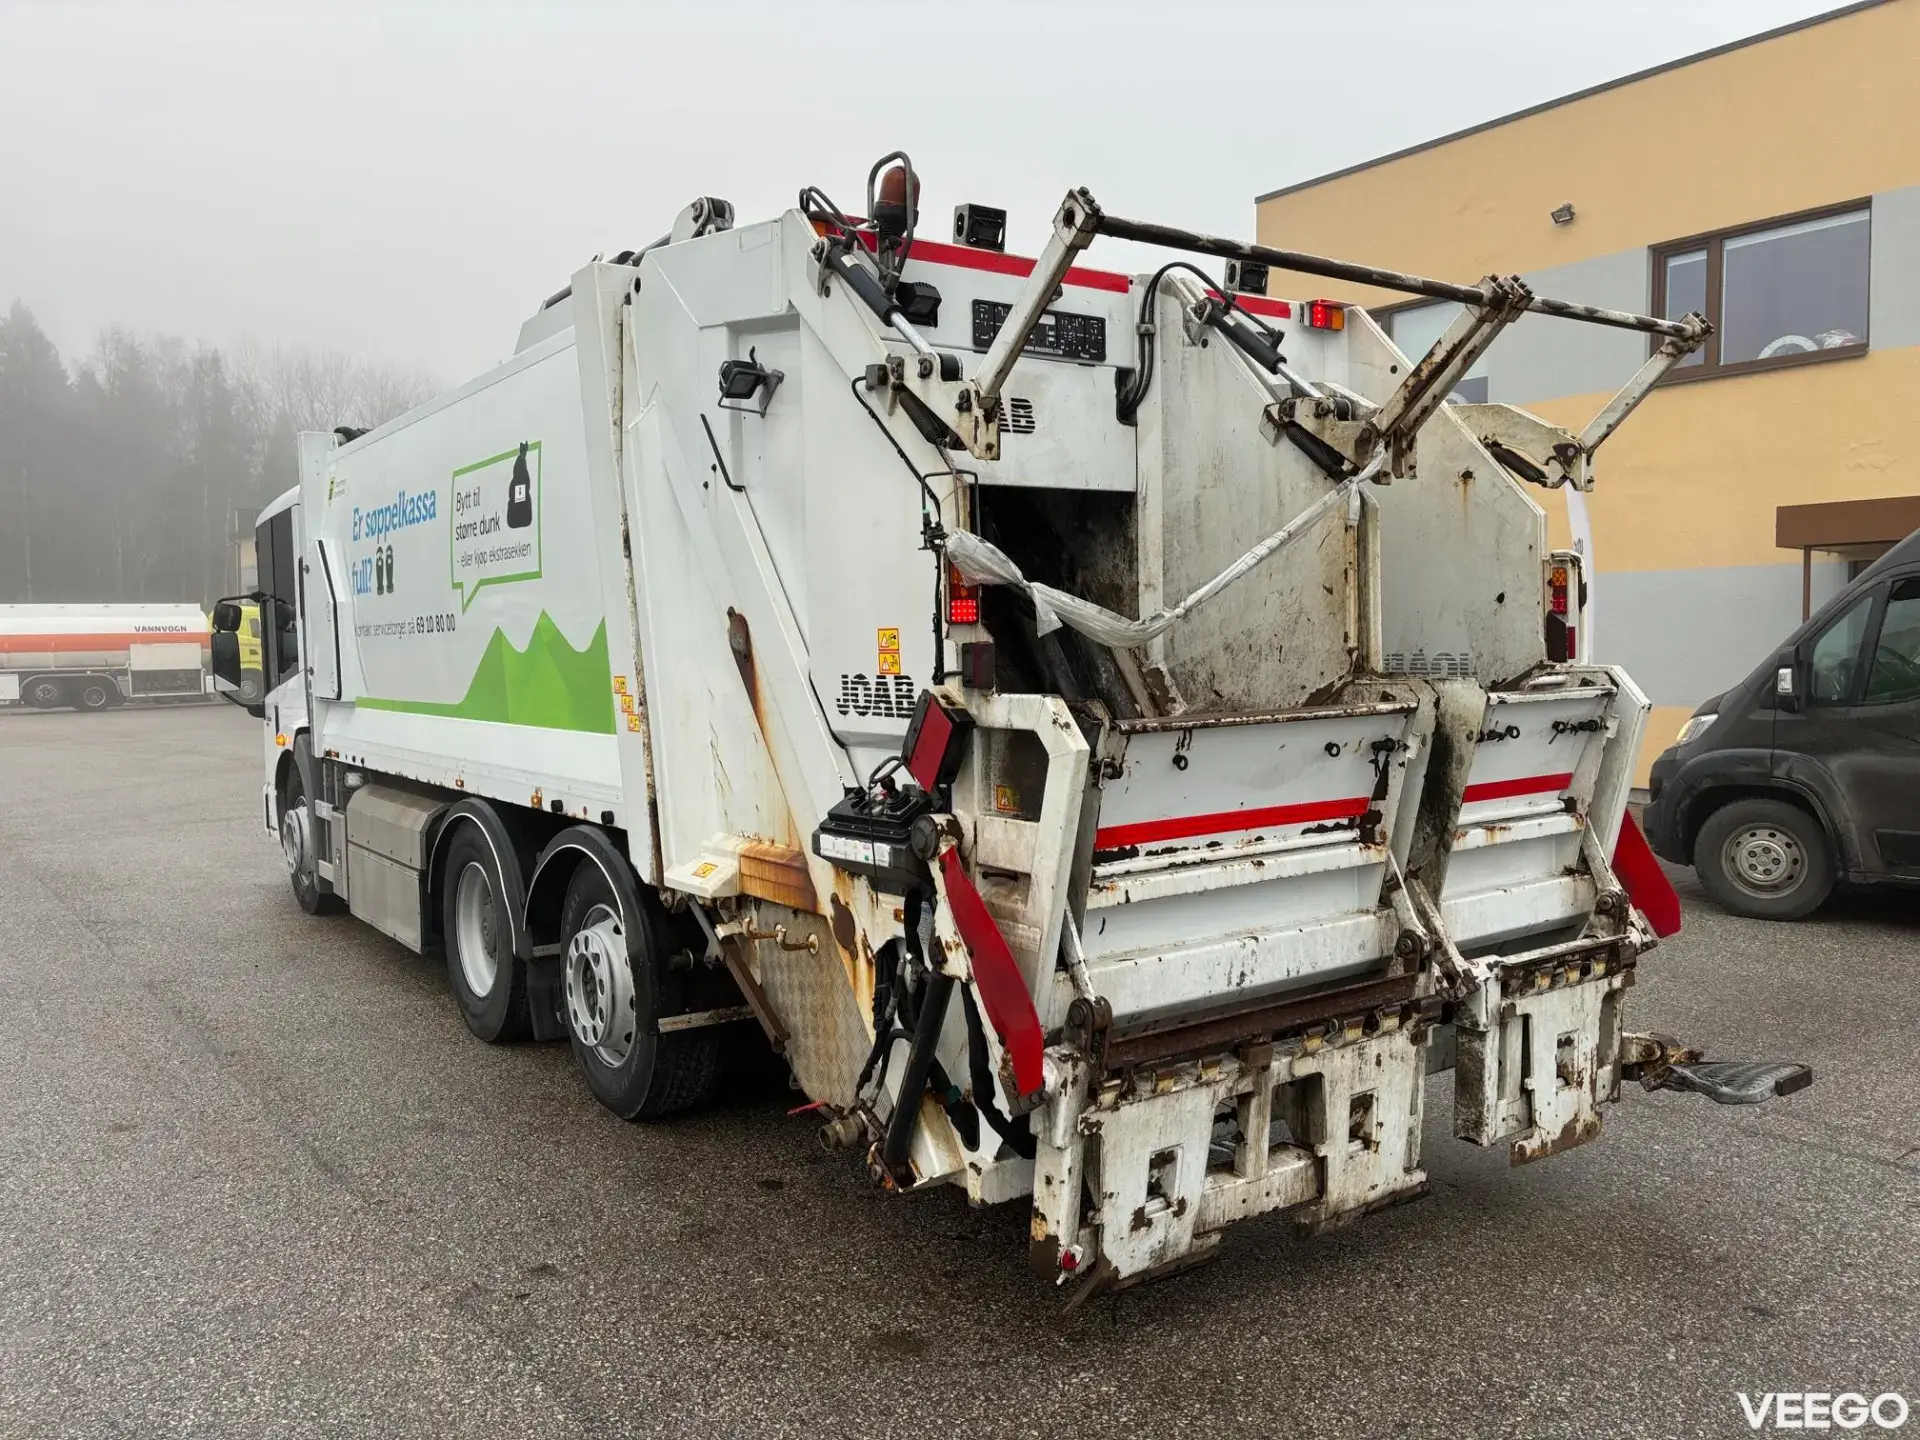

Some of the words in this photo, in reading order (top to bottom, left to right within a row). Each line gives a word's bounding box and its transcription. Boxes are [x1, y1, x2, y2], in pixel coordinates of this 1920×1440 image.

[353, 507, 363, 541] Er
[365, 490, 436, 545] søppelkassa
[456, 491, 471, 516] Bytt
[456, 521, 477, 540] større
[479, 510, 501, 535] dunk
[352, 557, 373, 595] full?
[416, 616, 425, 634] 69
[426, 615, 434, 633] 10
[435, 614, 445, 633] 80
[446, 613, 456, 632] 00
[836, 673, 916, 718] JOAB
